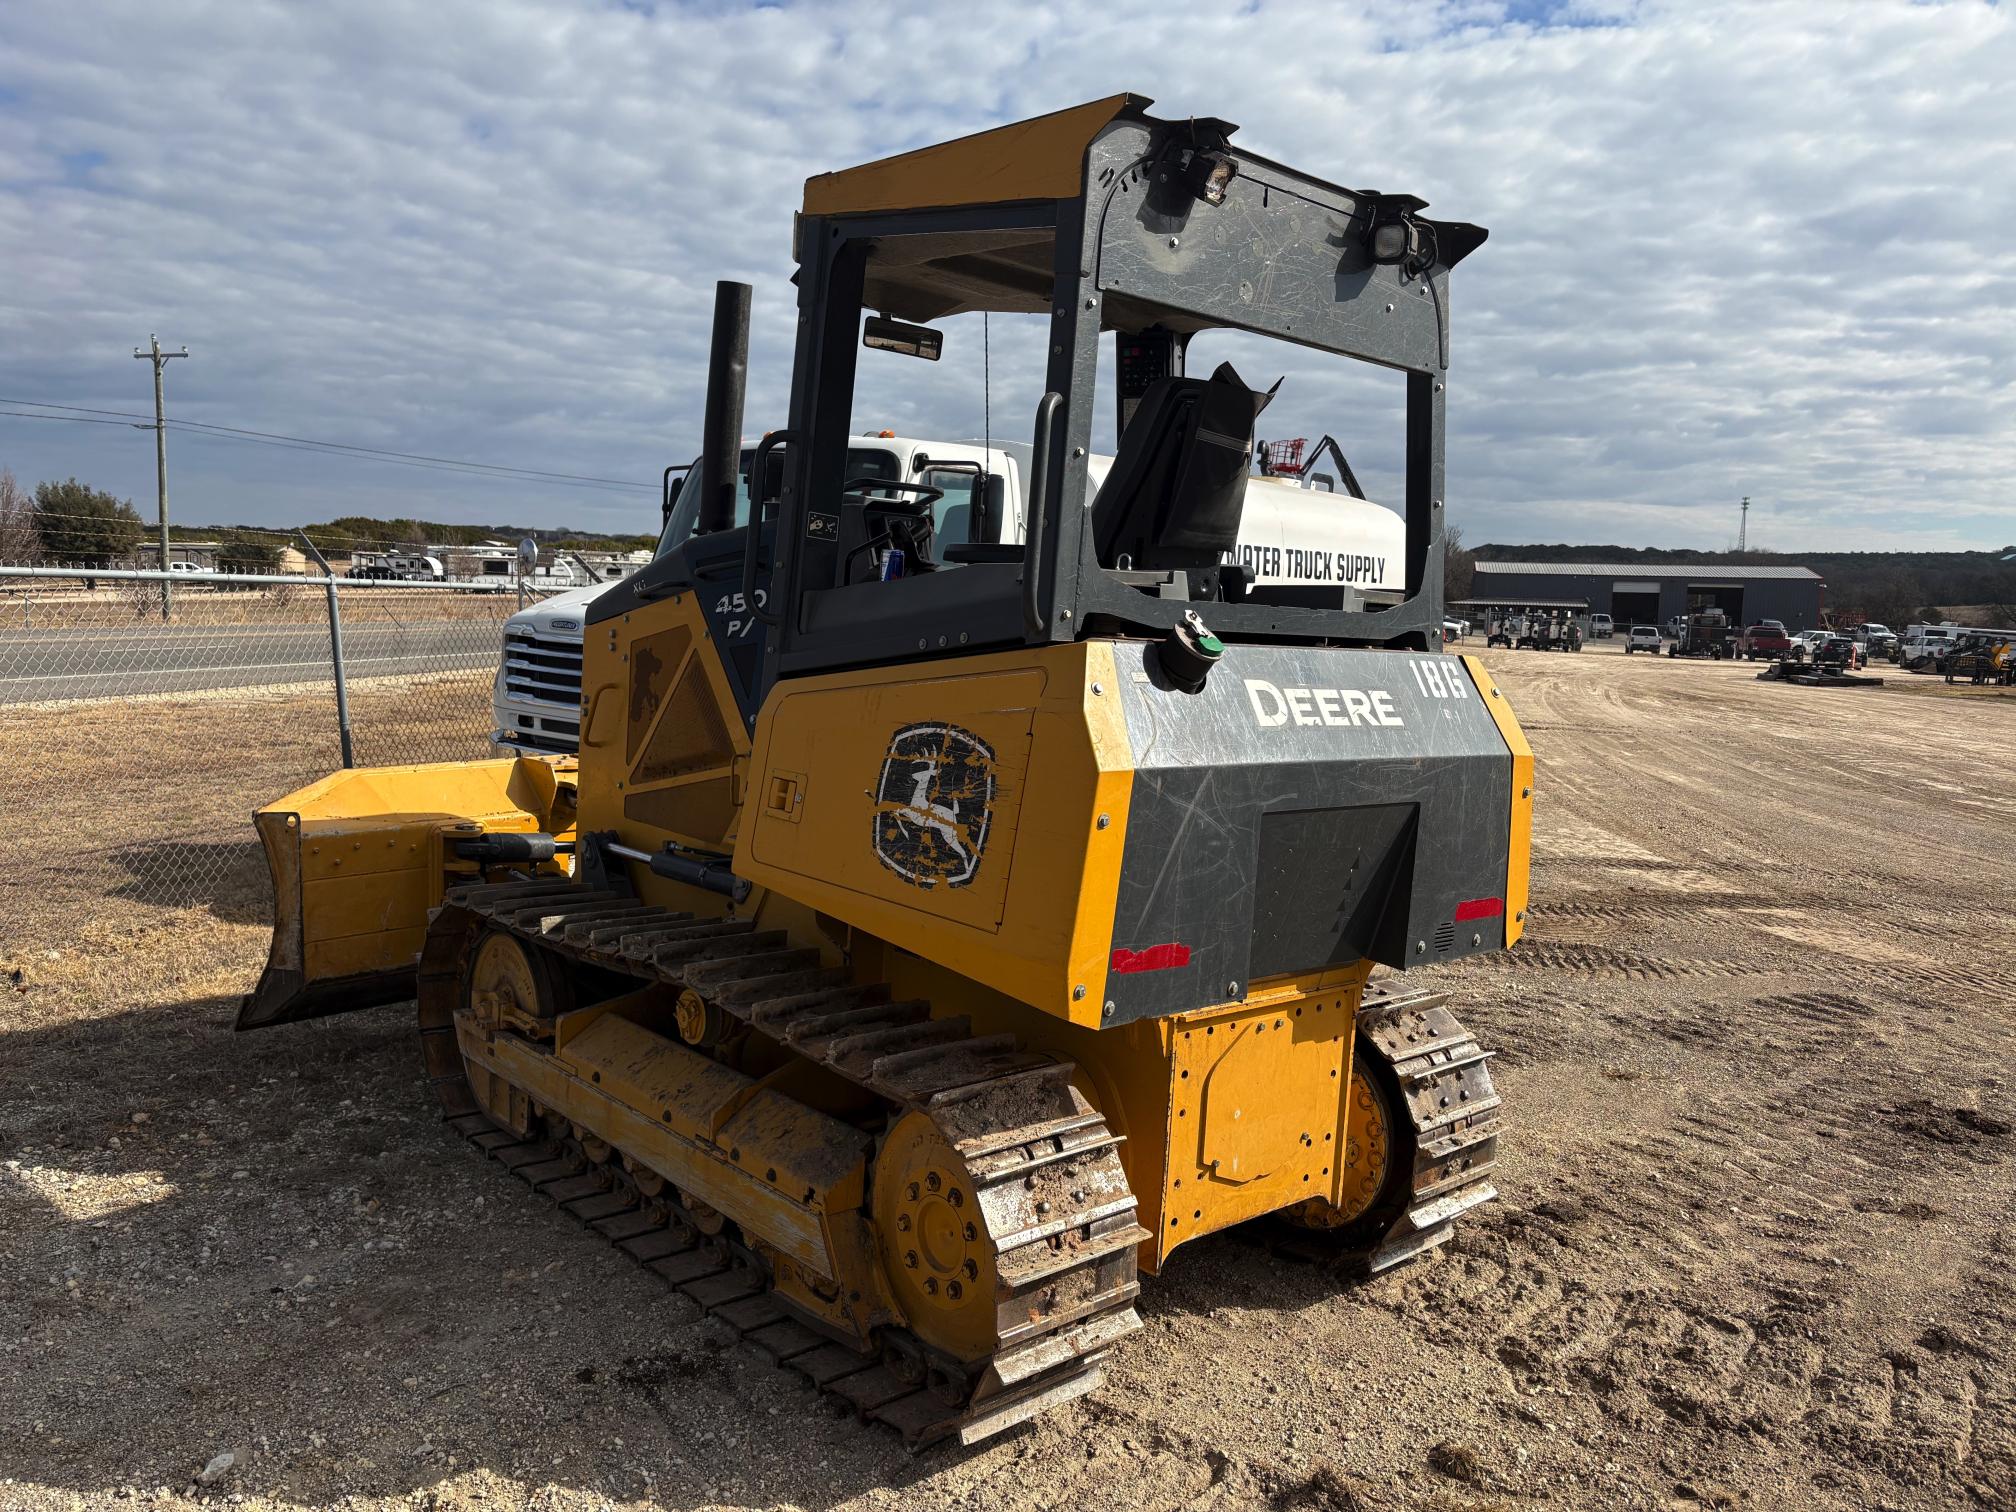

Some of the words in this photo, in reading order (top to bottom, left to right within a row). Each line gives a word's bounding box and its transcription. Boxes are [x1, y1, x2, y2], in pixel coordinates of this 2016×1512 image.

[1226, 544, 1281, 577] WATER
[1286, 549, 1332, 580] TRUCK
[1337, 553, 1385, 584] SUPPLY
[1243, 679, 1405, 727] DEERE
